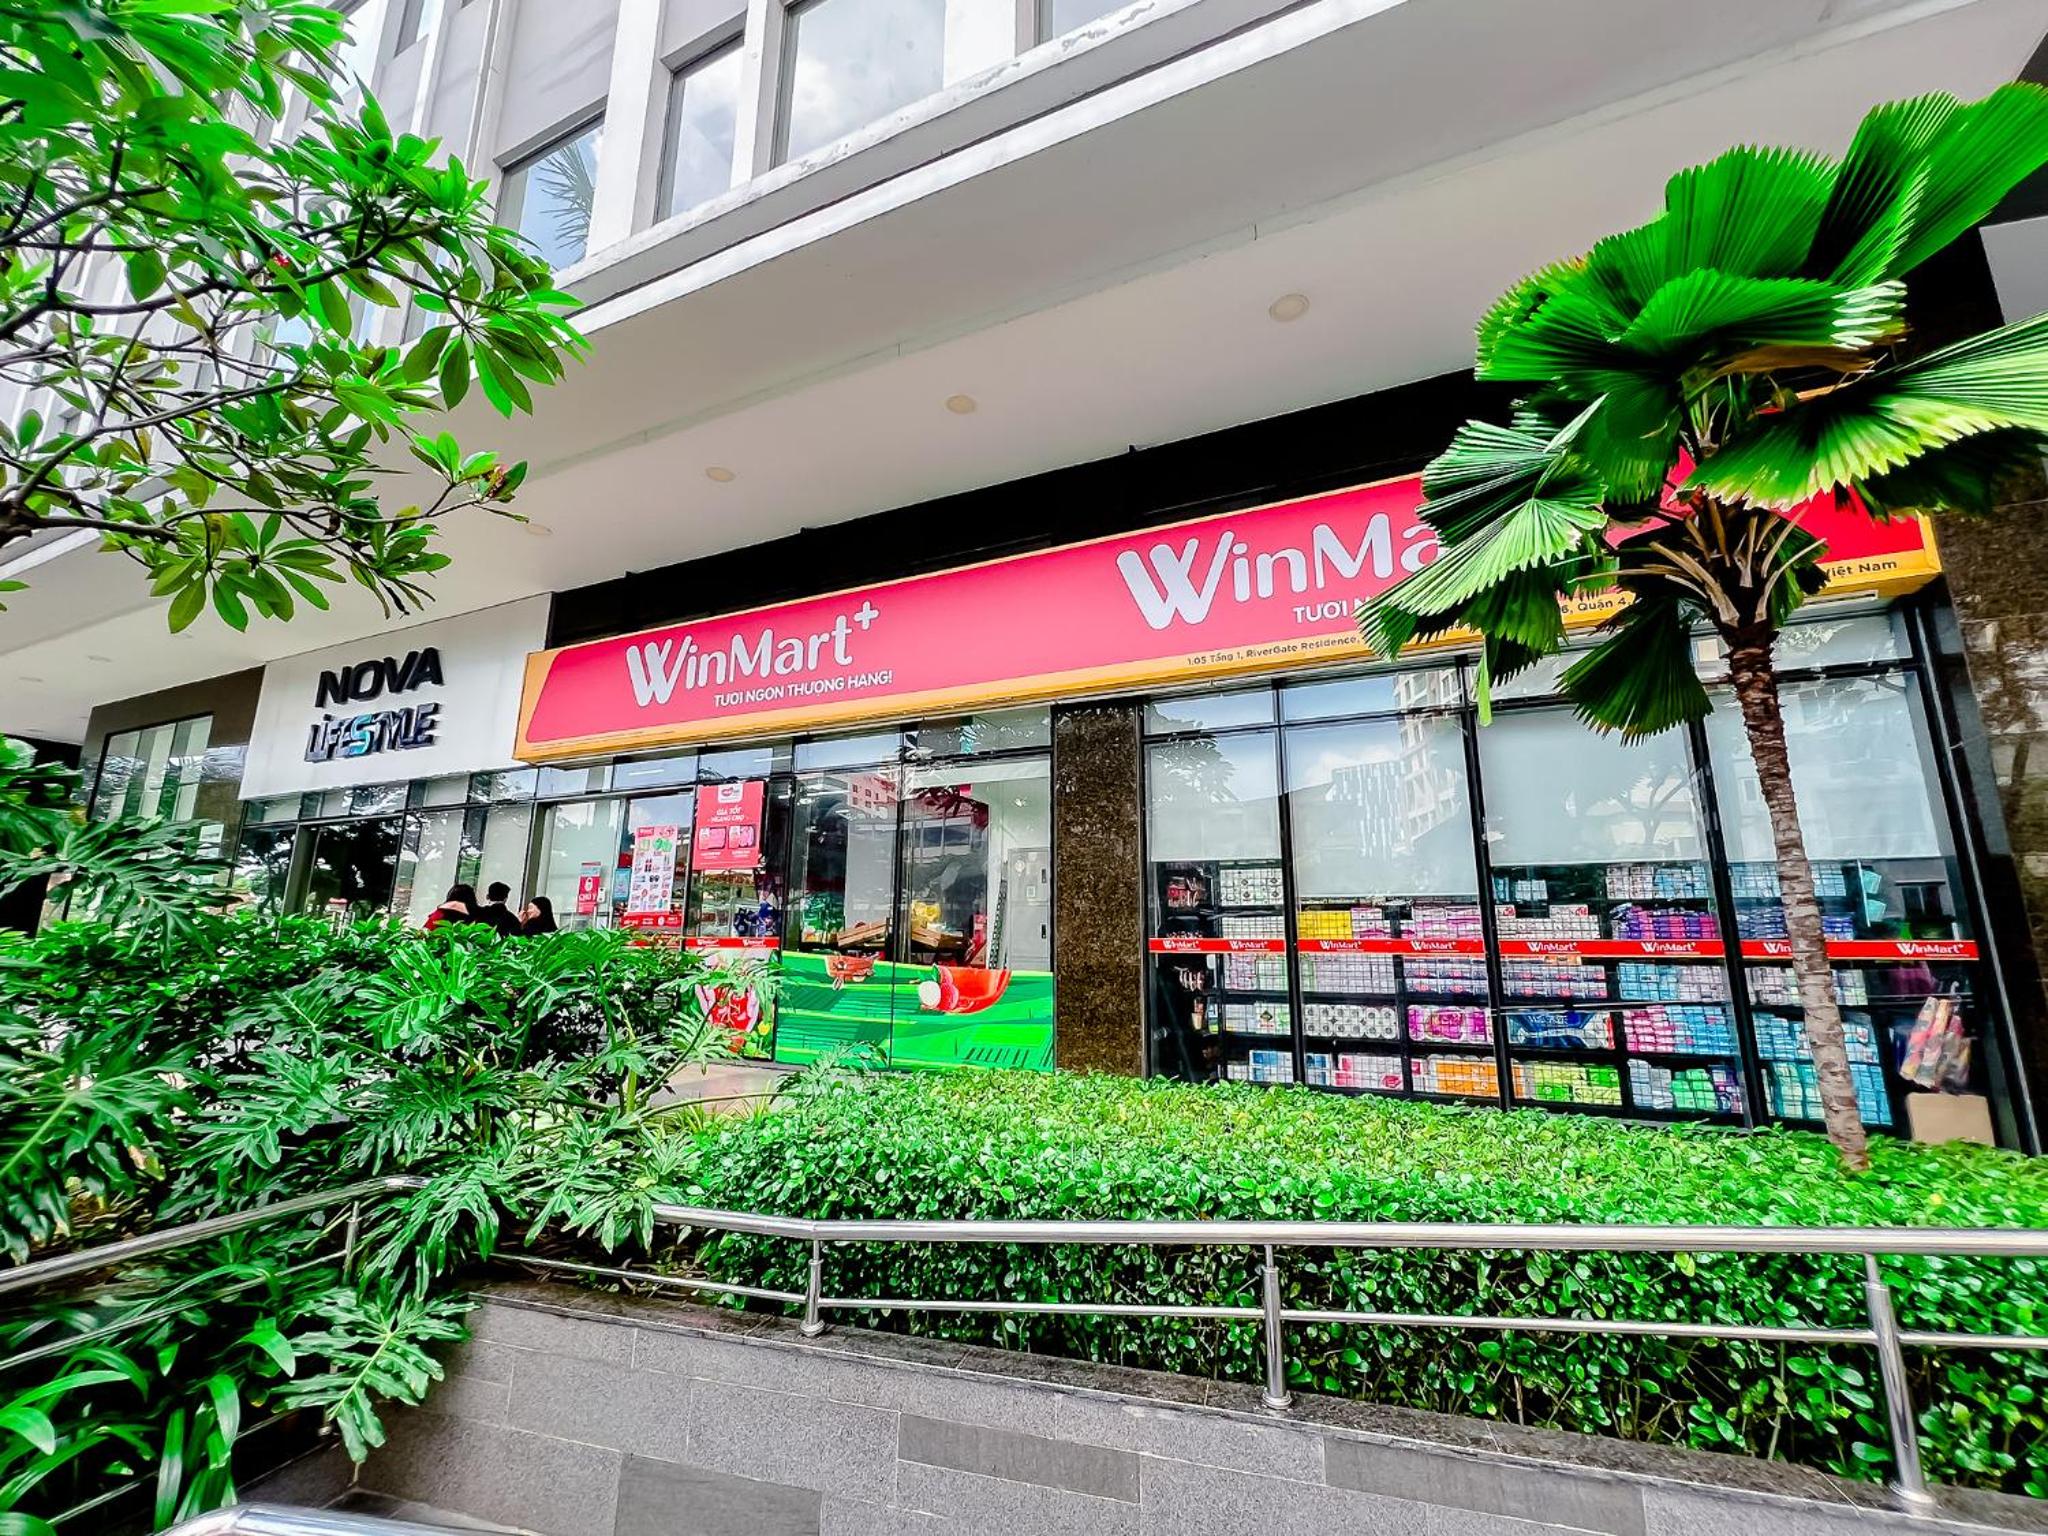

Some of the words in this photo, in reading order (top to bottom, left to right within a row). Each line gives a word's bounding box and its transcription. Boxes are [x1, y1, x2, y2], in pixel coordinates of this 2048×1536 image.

[1117, 512, 1448, 630] WinMa
[1246, 644, 1298, 658] RiverGate
[1578, 599, 1614, 611] Quận
[1859, 561, 1897, 573] Nam
[315, 647, 444, 708] NOVA
[746, 685, 784, 702] NGON
